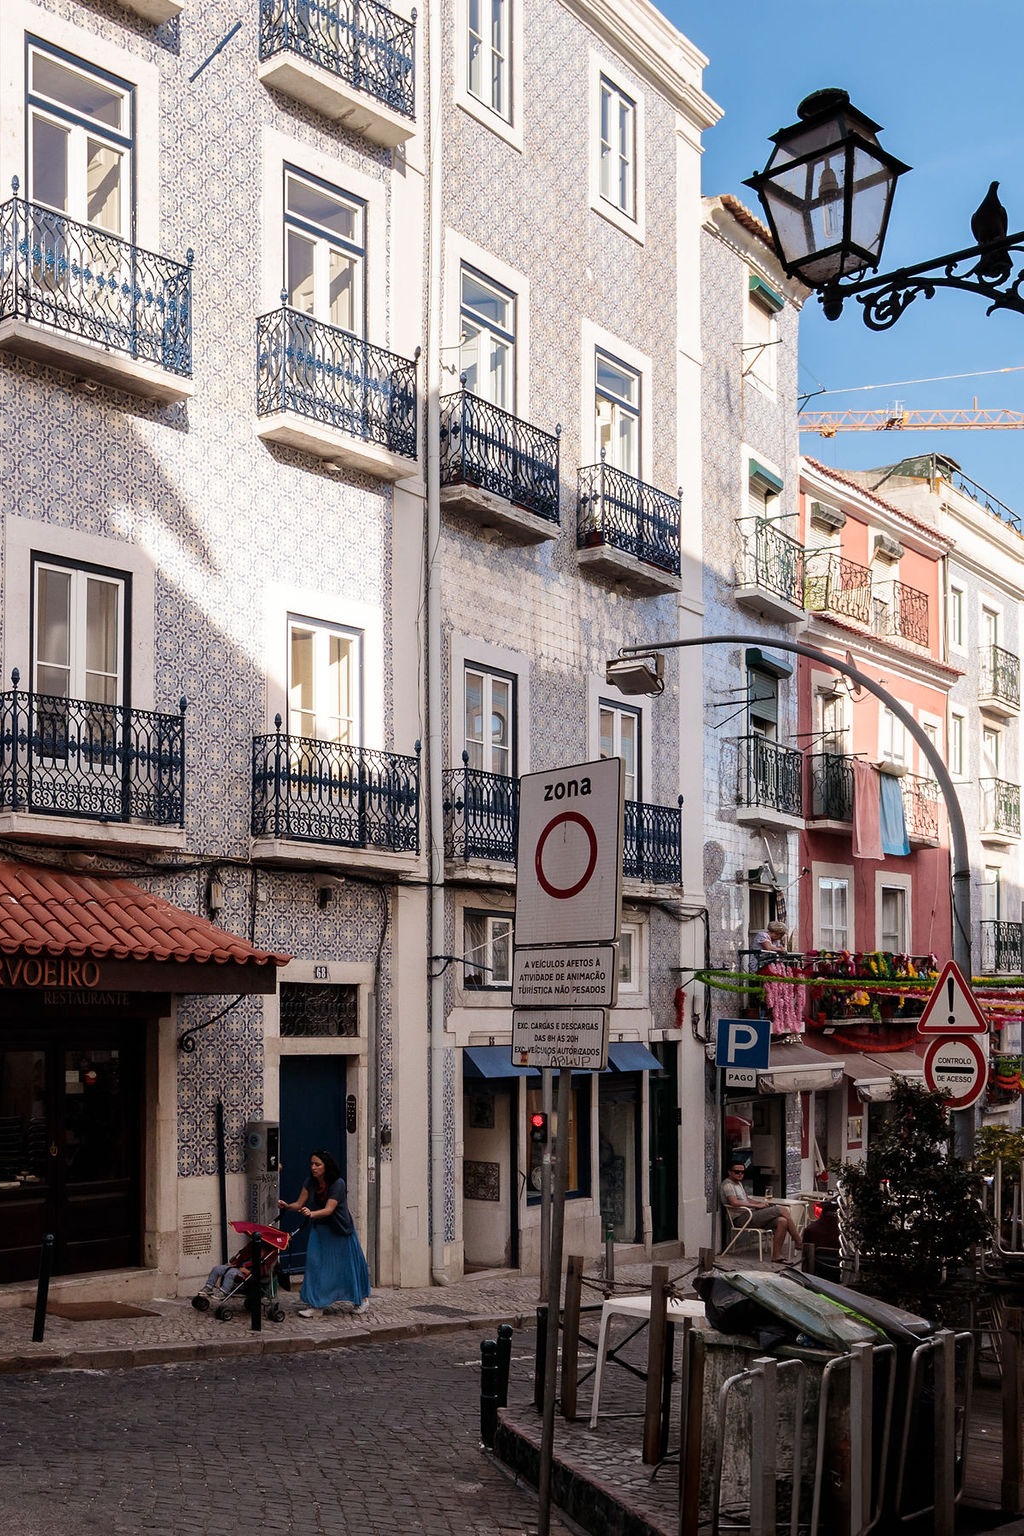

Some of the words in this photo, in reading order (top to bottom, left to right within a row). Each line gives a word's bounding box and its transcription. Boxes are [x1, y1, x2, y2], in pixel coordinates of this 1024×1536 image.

[544, 778, 591, 801] zona
[531, 959, 564, 968] VEÍCULOS
[566, 959, 593, 967] AFETOS
[595, 957, 601, 966] À
[316, 967, 326, 978] 68
[567, 971, 606, 981] ANIMAÇÃO
[518, 985, 553, 994] TURÍSTICA
[555, 985, 570, 994] NÃO
[43, 991, 129, 1006] RESTAURANTE
[728, 1024, 758, 1062] P
[528, 1045, 555, 1054] VEÍCULOS
[558, 1047, 600, 1055] AUTORIZADOS
